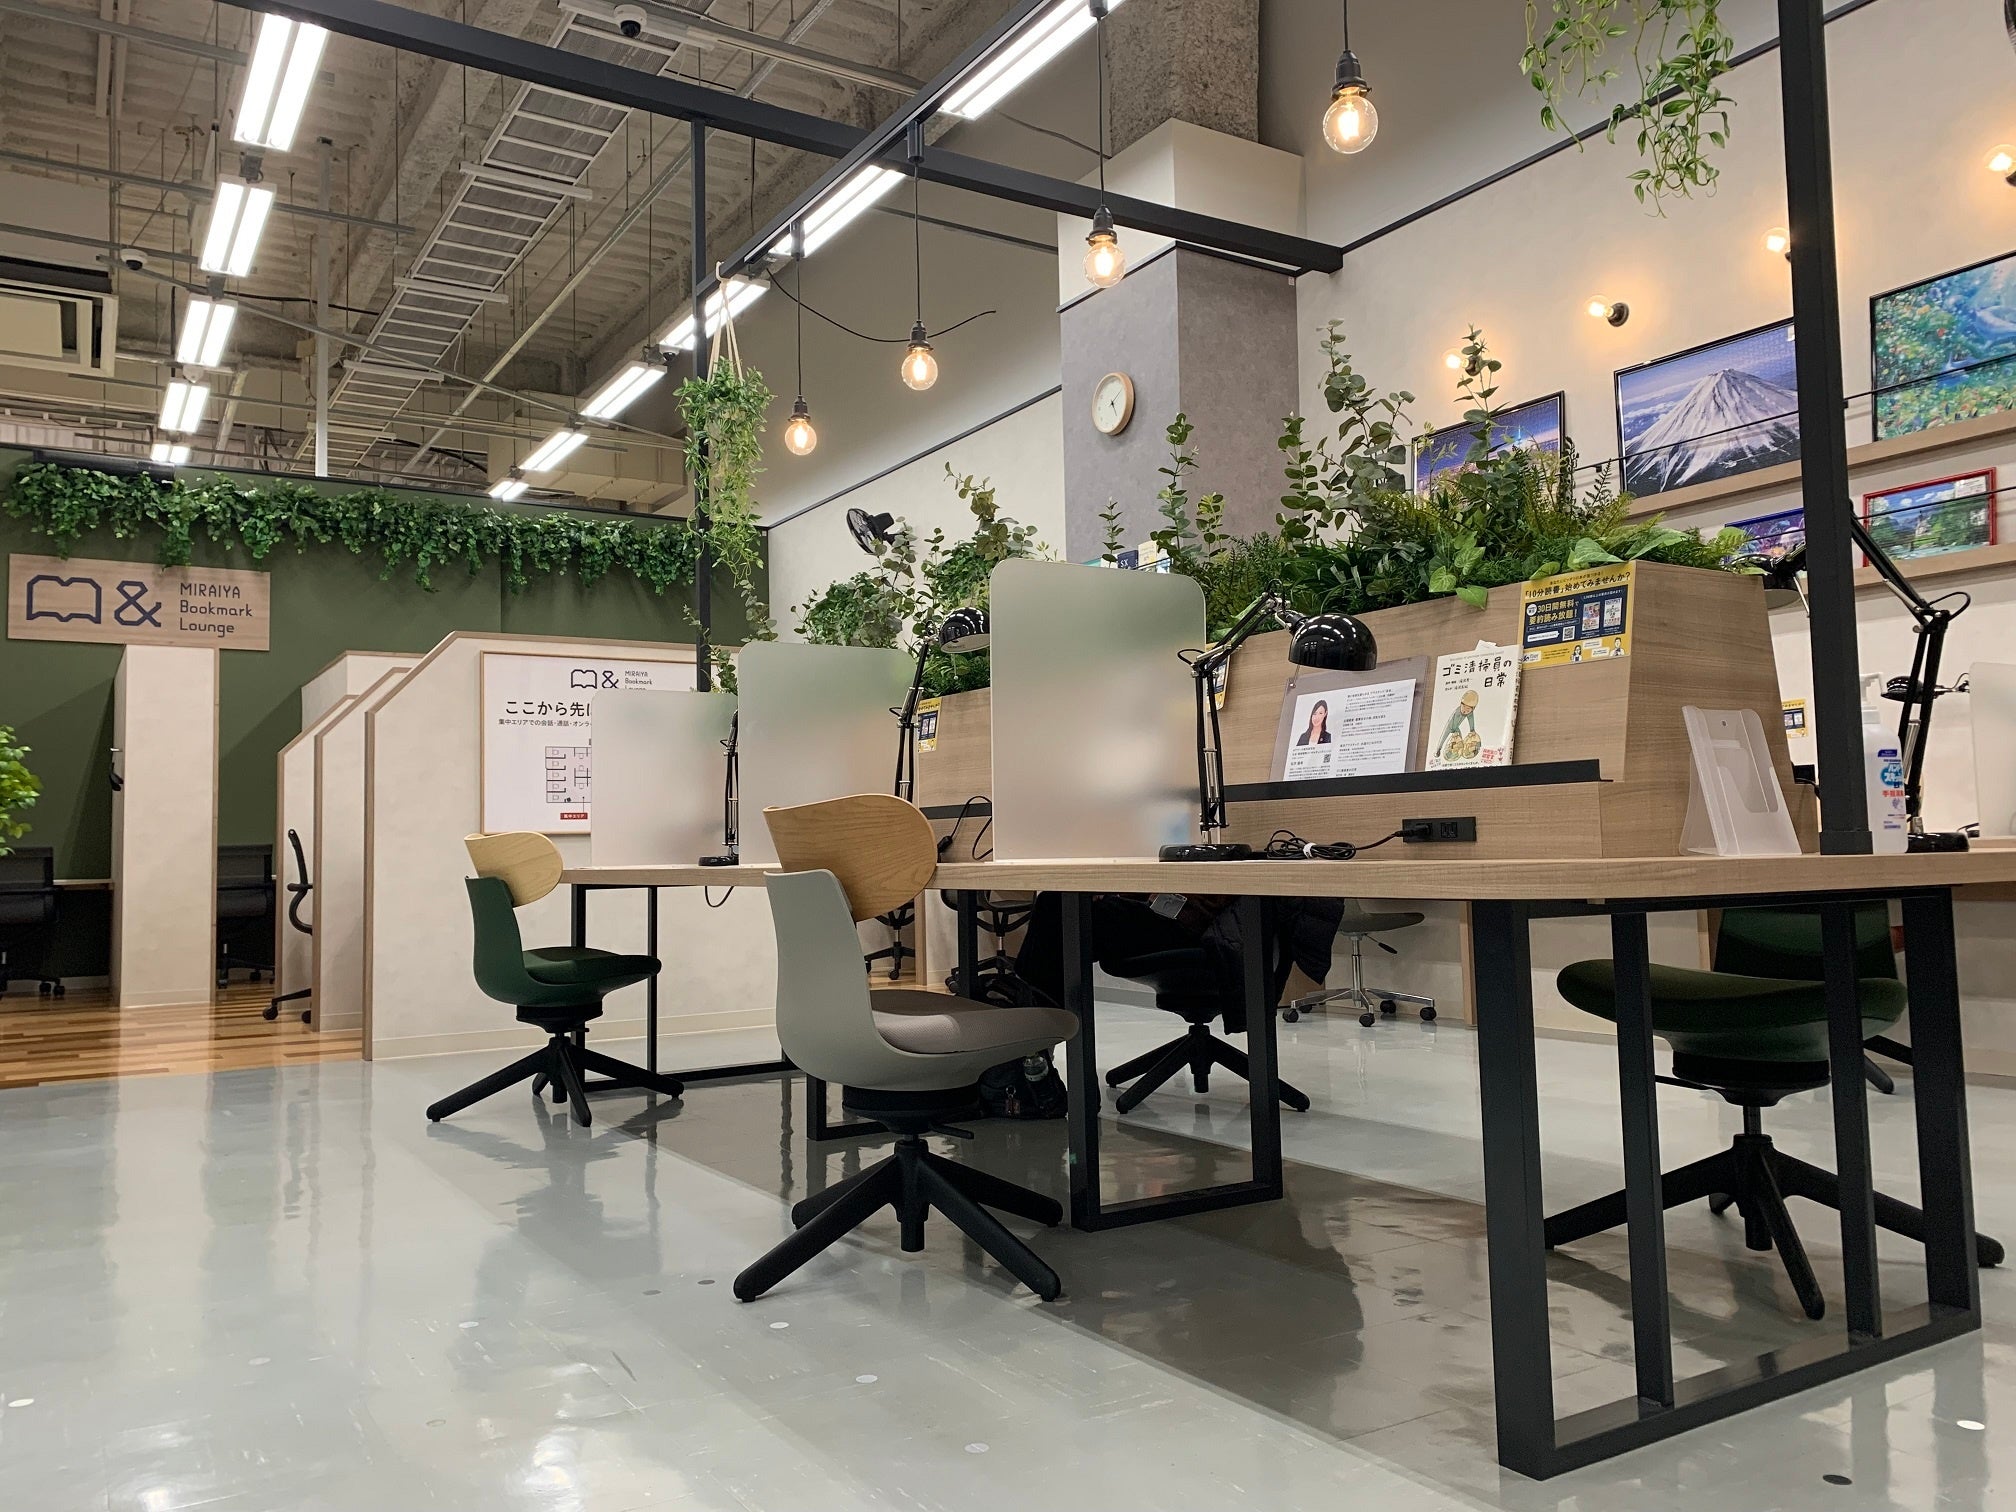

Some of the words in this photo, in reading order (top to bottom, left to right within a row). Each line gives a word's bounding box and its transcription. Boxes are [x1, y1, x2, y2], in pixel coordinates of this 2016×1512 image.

[180, 583, 241, 599] MIRAIYA
[179, 600, 253, 617] Bookmark
[179, 618, 235, 638] Lounge
[1442, 656, 1512, 677] ゴミ清掃員の
[625, 677, 652, 685] Bookmark
[1484, 671, 1507, 688] 日常
